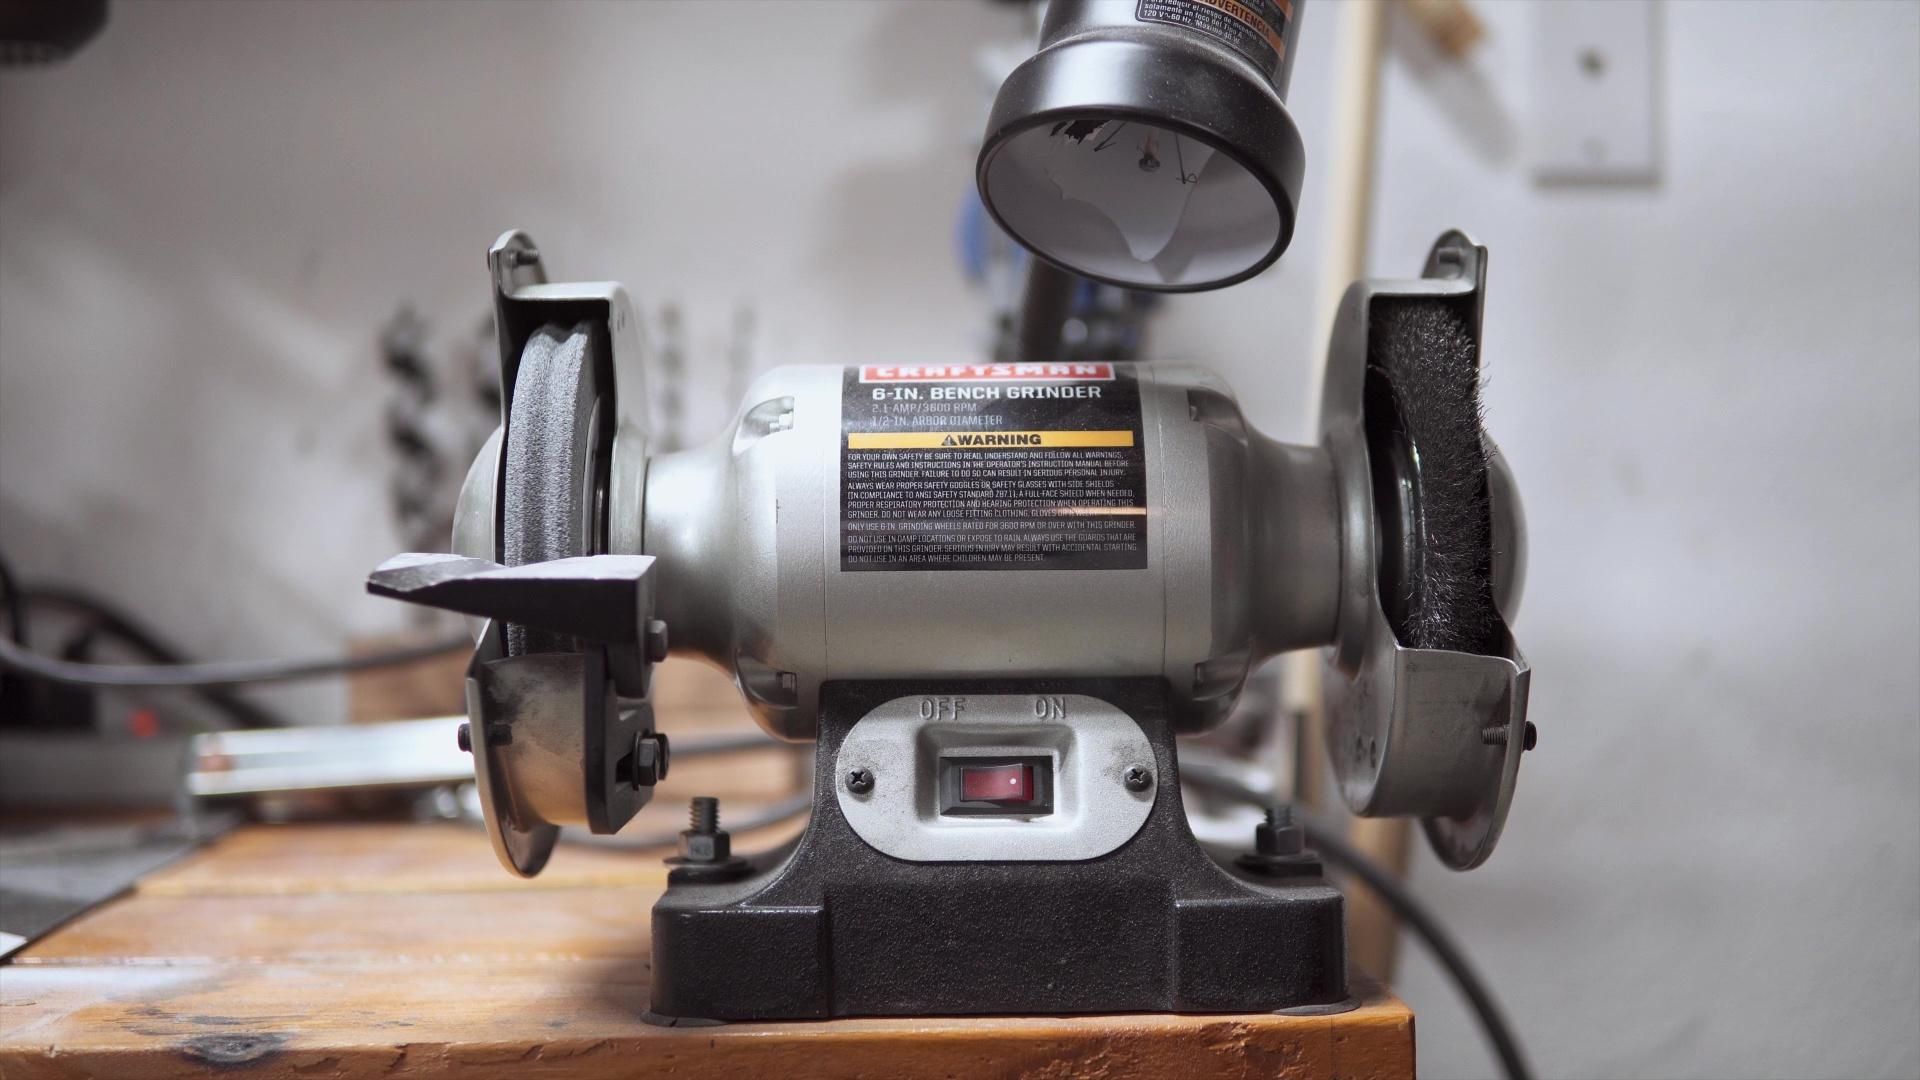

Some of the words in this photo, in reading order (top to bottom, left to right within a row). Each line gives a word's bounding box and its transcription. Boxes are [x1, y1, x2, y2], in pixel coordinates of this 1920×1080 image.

[1144, 3, 1183, 14] solamente
[1195, 12, 1210, 22] foco
[1144, 9, 1157, 17] 120
[876, 365, 1098, 378] CRAFTSMAN
[872, 387, 924, 400] 6-IN.
[930, 387, 1000, 400] BENCH
[1007, 386, 1102, 399] GRINDER
[953, 403, 977, 412] RPM
[912, 415, 947, 426] ARBOR
[949, 415, 1003, 425] DIAMETER
[958, 434, 1042, 446] WARNING
[848, 453, 860, 461] FOR
[984, 452, 1028, 460] UNDERSTAND
[1030, 452, 1043, 460] AND
[912, 461, 960, 469] INSTRUCTIONS
[848, 470, 869, 478] USING
[871, 470, 886, 478] THIS
[922, 470, 950, 478] FAILURE
[860, 491, 903, 499] COMPLIANCE
[906, 491, 914, 499] TO
[916, 491, 932, 499] ANSI
[934, 491, 958, 499] SAFETY
[960, 490, 994, 498] STANDARD
[1018, 490, 1024, 498] A
[1060, 490, 1084, 498] SHIELD
[1086, 490, 1105, 498] WHEN
[848, 501, 874, 509] PROPER
[923, 500, 964, 508] PROTECTION
[966, 500, 980, 508] AND
[982, 500, 1012, 508] HEARING
[1118, 499, 1134, 507] THIS
[908, 510, 927, 518] WEAR
[928, 510, 941, 518] ANY
[943, 510, 964, 518] LOOSE
[848, 522, 864, 530] ONLY
[866, 522, 878, 530] USE
[898, 522, 932, 530] GRINDING
[934, 522, 960, 530] WHEELS
[962, 522, 984, 530] RATED
[1037, 521, 1047, 529] OR
[1048, 521, 1066, 529] OVER
[1067, 521, 1084, 529] WITH
[1087, 521, 1102, 529] THIS
[848, 535, 858, 543] DO
[860, 535, 872, 543] NOT
[874, 535, 886, 543] USE
[888, 535, 896, 543] IN
[898, 535, 916, 543] DAMP
[1024, 534, 1050, 542] ALWAYS
[848, 545, 882, 553] PROVIDED
[883, 545, 892, 553] ON
[895, 545, 910, 553] THIS
[976, 544, 1000, 552] INJURY
[1001, 544, 1016, 552] MAY
[1016, 544, 1040, 552] RESULT
[1042, 544, 1060, 552] WITH
[1062, 544, 1102, 552] ACCIDENTAL
[848, 555, 858, 563] DO
[860, 555, 872, 563] NOT
[874, 555, 886, 563] USE
[888, 555, 896, 563] IN
[898, 555, 908, 563] AN
[952, 554, 987, 562] CHILDREN
[988, 554, 1002, 562] MAY
[1004, 554, 1013, 562] BE
[918, 698, 966, 721] OFF
[1033, 697, 1067, 720] ON
